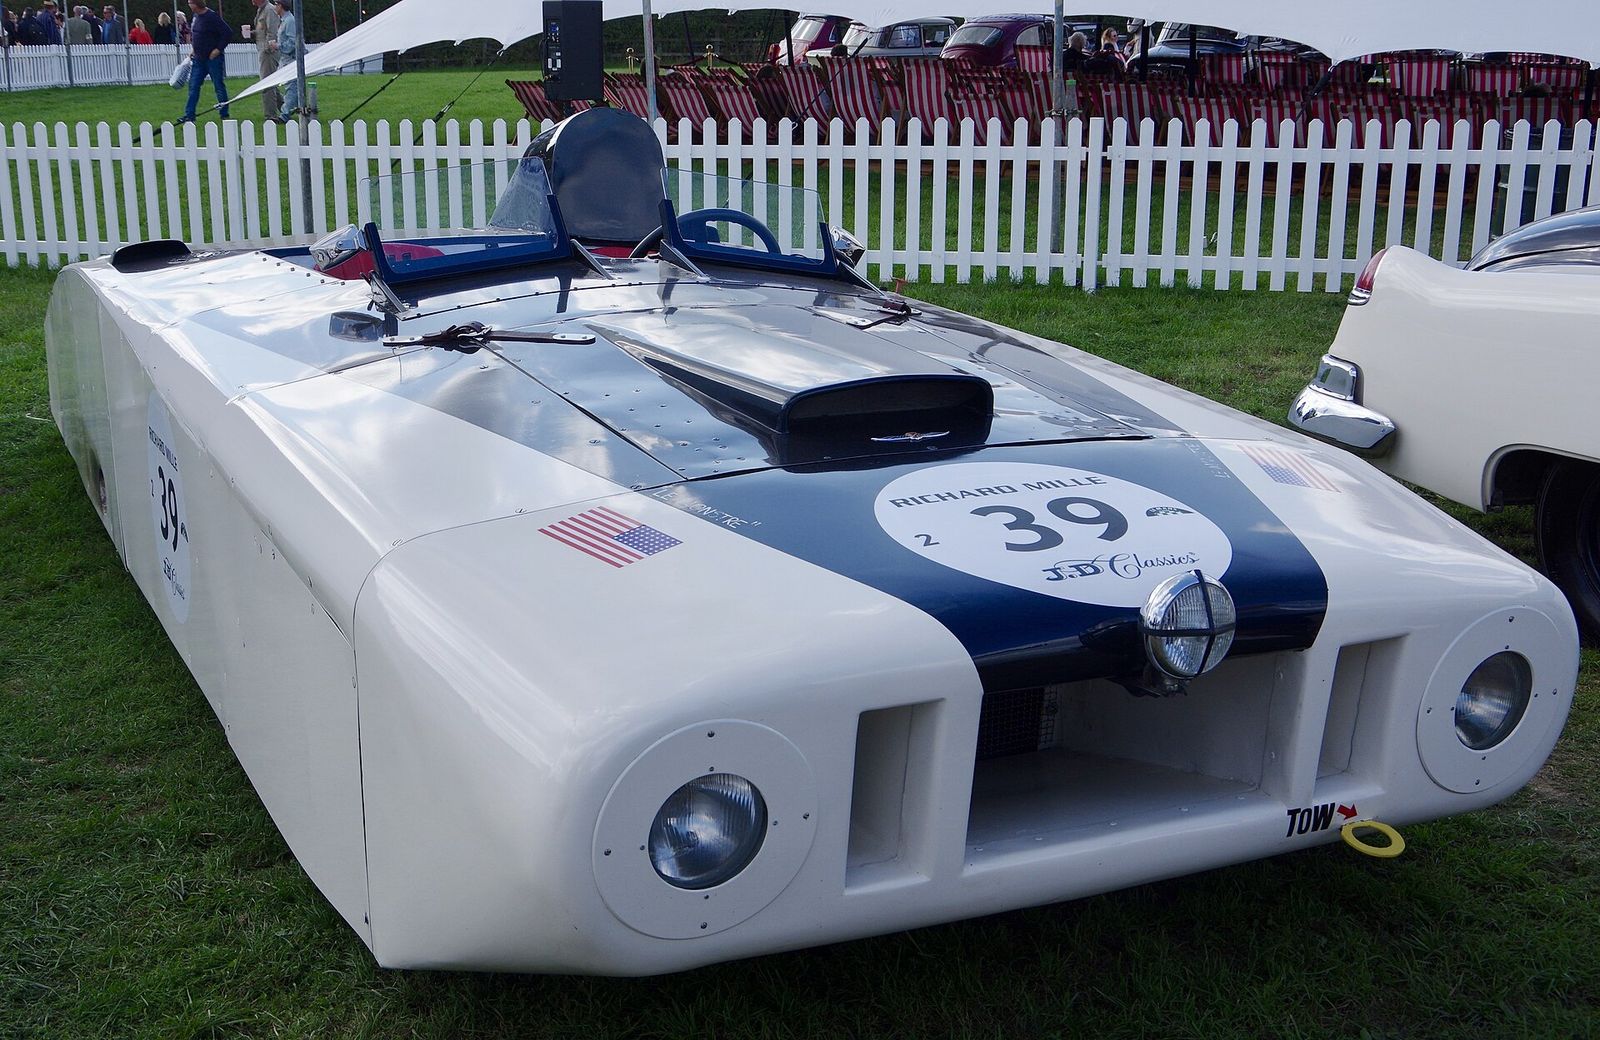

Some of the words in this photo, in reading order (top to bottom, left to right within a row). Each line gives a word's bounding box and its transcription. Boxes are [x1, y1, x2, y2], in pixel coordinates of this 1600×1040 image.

[157, 465, 179, 553] 39
[888, 484, 1018, 508] RICHARD
[1021, 476, 1107, 492] MILLE
[914, 533, 940, 547] 2
[969, 496, 1129, 552] 39
[1286, 802, 1336, 838] TOW
